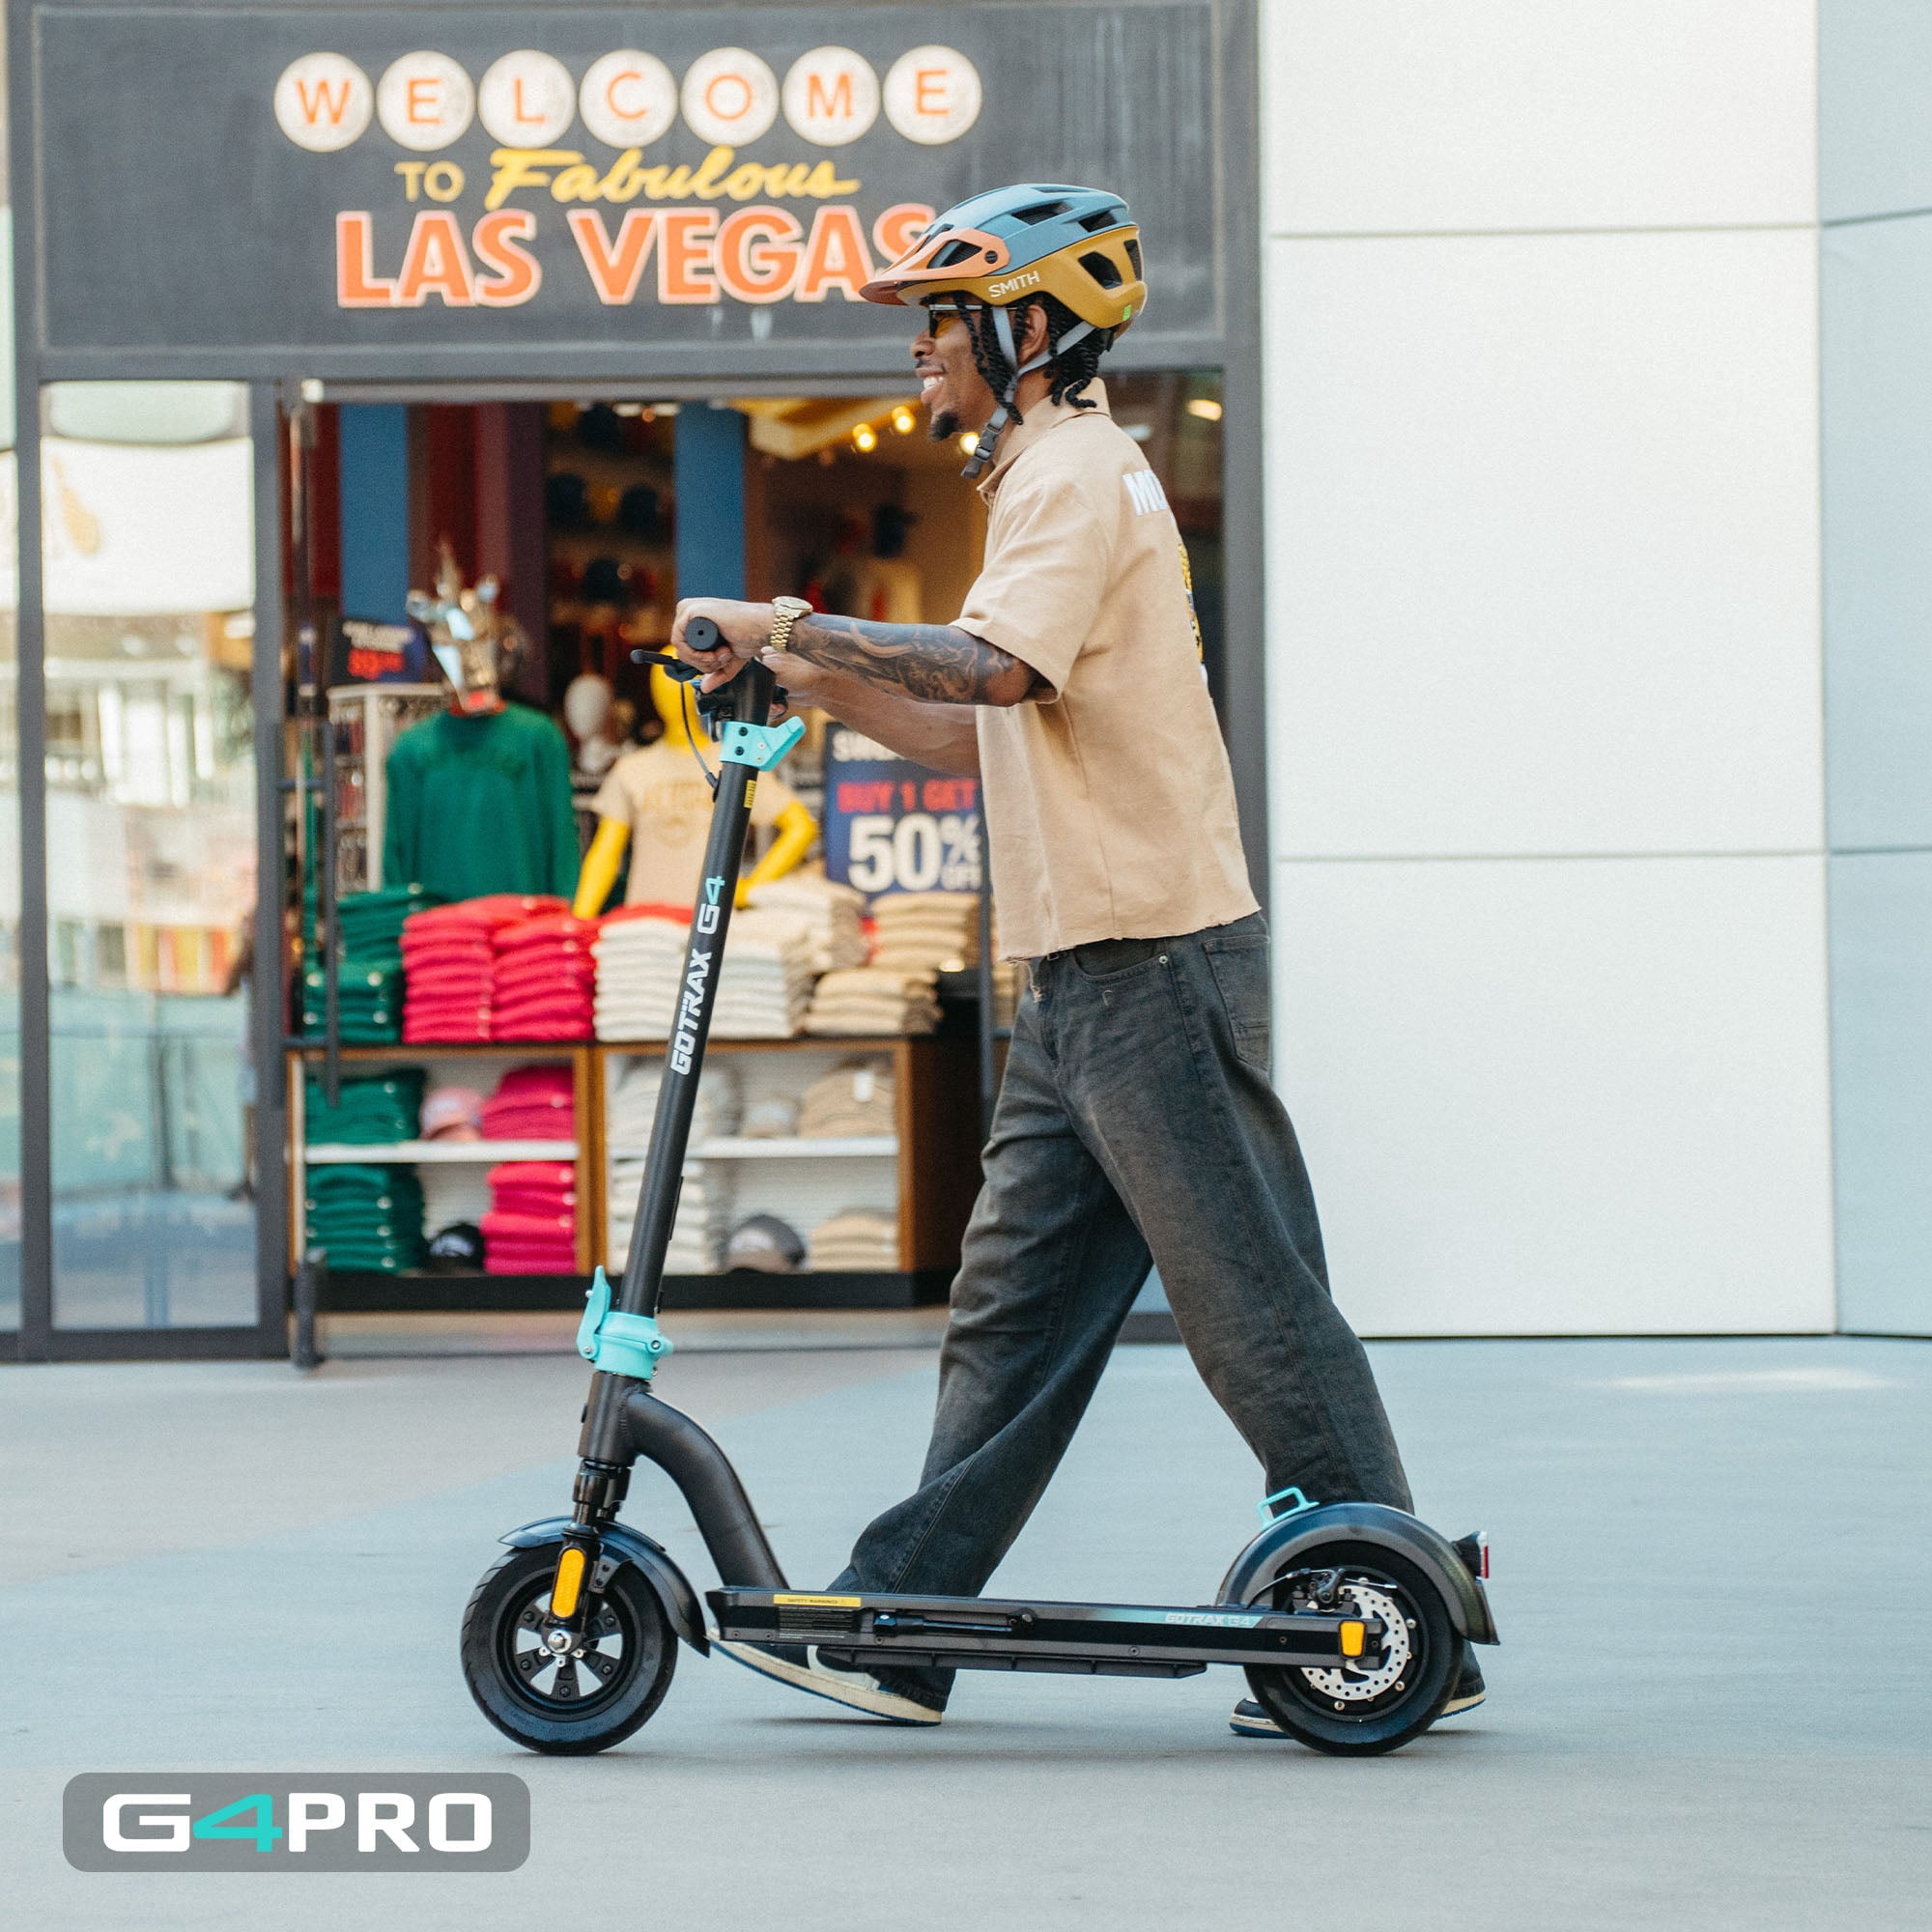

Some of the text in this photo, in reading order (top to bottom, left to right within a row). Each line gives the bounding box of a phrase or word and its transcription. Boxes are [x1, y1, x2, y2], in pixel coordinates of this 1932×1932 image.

[293, 67, 954, 128] WELCOME
[394, 145, 862, 212] TO Fabulous
[336, 203, 936, 308] LAS VEGAS
[988, 270, 1041, 298] SMITH
[670, 875, 725, 1076] GOTRAX G4
